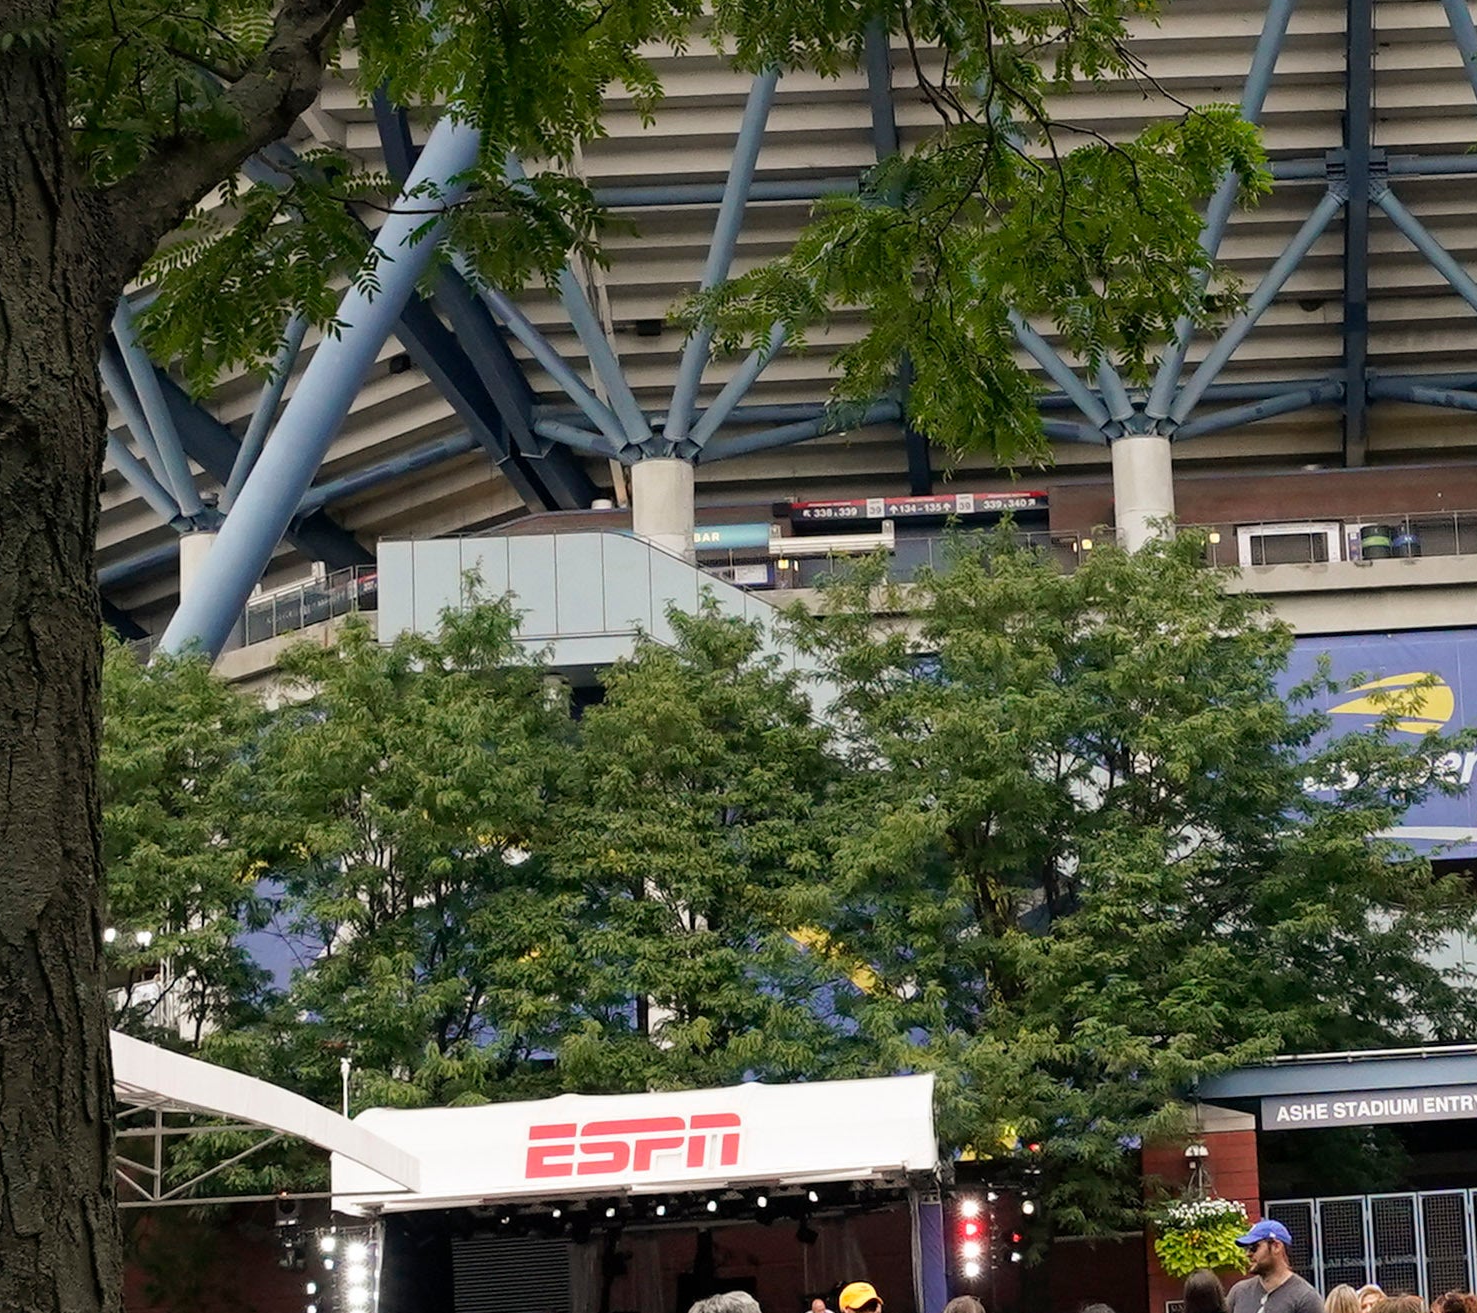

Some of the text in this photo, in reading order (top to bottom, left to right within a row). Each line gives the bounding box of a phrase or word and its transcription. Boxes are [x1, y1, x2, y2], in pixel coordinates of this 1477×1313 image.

[899, 505, 917, 514] 134
[924, 503, 942, 513] 135
[694, 532, 720, 542] BAR
[1276, 1102, 1329, 1122] ASHE
[1333, 1097, 1418, 1120] STADIUM
[525, 1112, 742, 1179] ESPN
